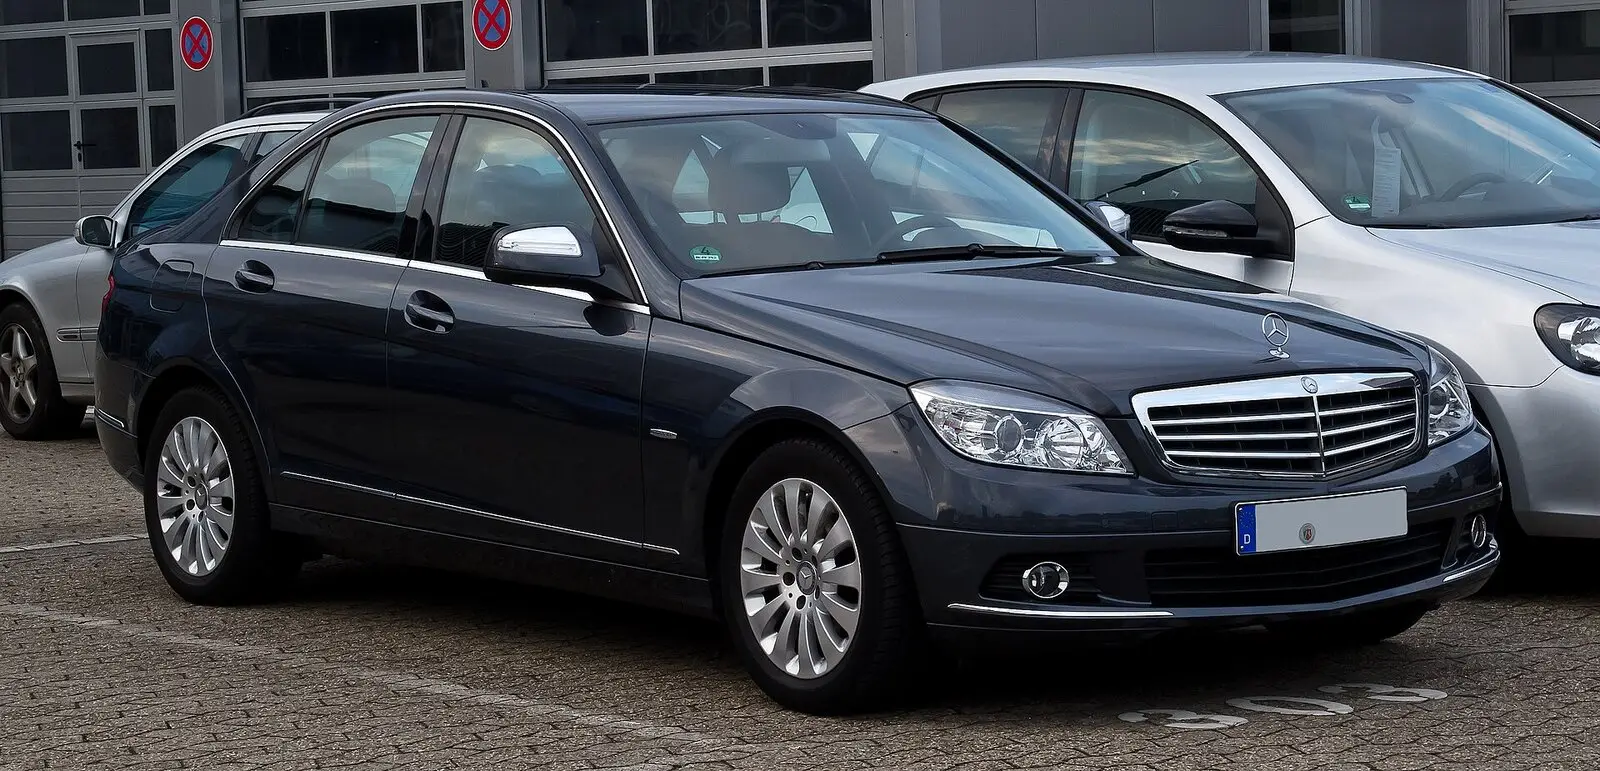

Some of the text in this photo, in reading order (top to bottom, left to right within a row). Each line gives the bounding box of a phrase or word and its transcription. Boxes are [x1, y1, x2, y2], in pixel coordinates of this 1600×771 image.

[701, 246, 710, 255] 4
[1243, 534, 1251, 544] D
[1117, 683, 1448, 729] 303
